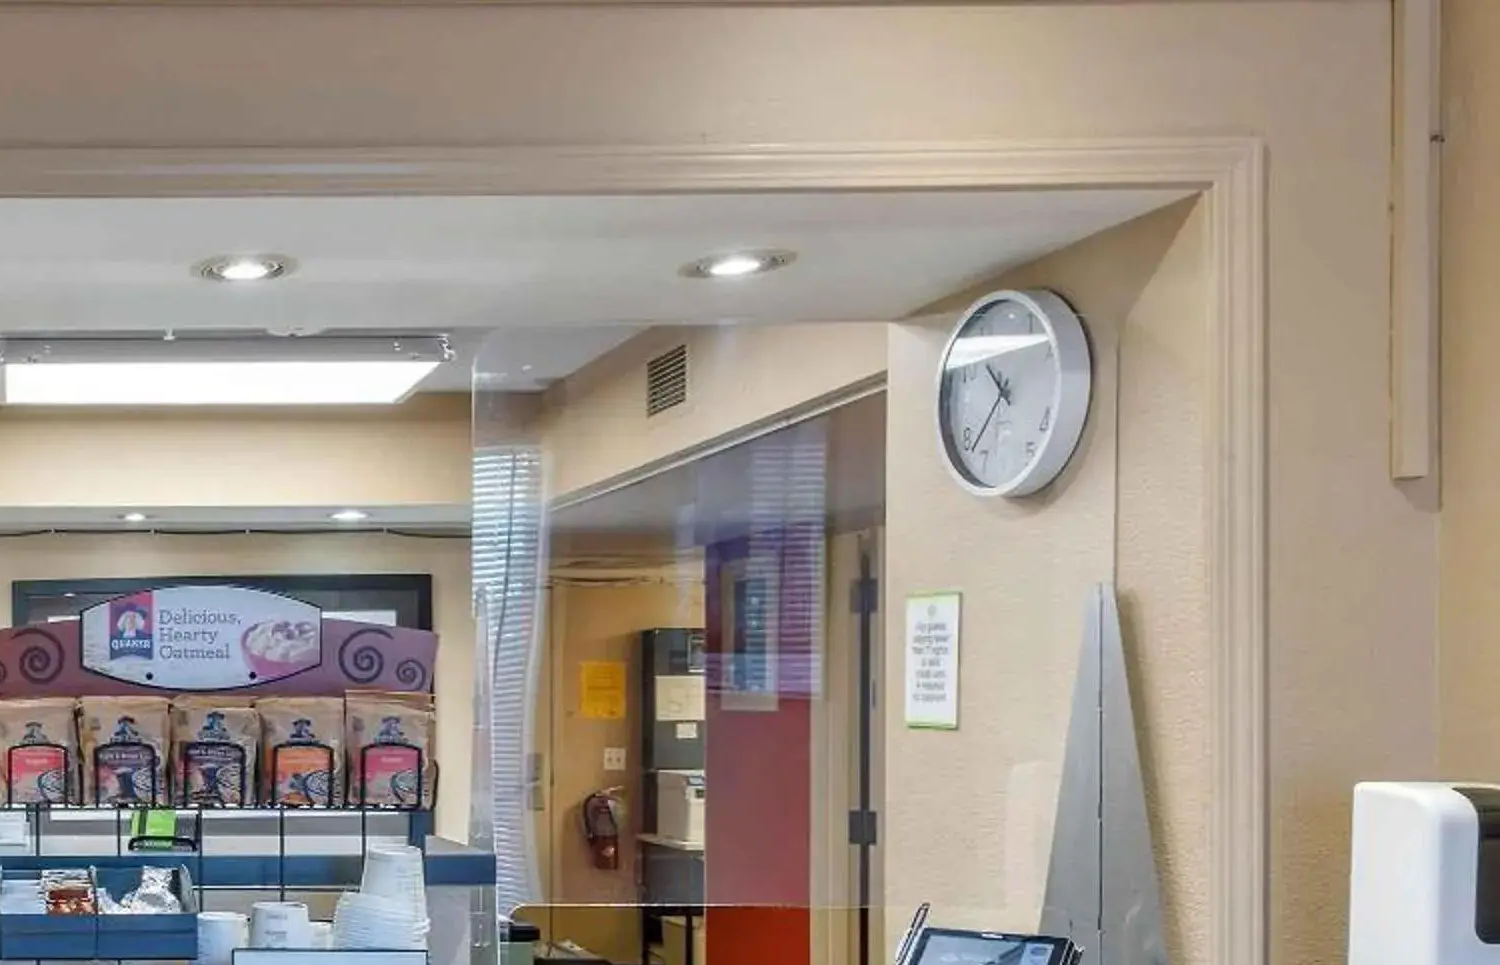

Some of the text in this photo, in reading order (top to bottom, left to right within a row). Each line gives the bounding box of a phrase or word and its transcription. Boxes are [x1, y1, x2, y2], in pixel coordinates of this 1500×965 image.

[963, 427, 972, 451] 8
[980, 450, 990, 474] 7
[159, 608, 242, 625] Delicious,
[111, 639, 151, 649] QUAKER
[159, 628, 219, 644] Hearty
[159, 644, 231, 659] Oatmeal
